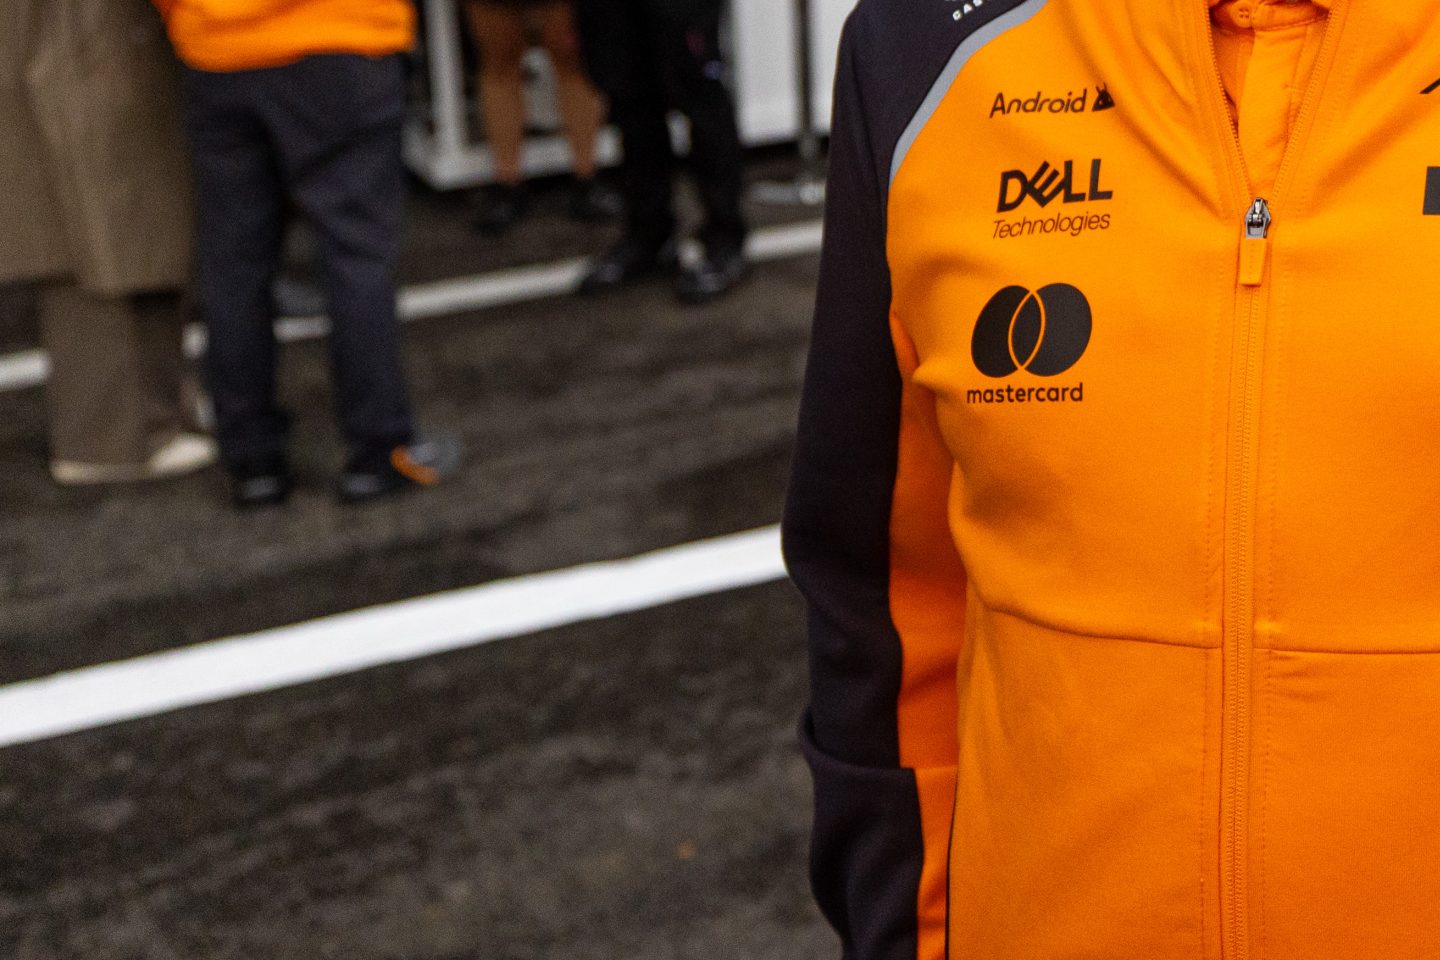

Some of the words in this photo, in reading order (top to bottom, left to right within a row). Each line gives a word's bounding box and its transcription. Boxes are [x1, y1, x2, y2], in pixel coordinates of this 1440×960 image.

[989, 88, 1088, 119] Android
[995, 158, 1114, 214] DELL
[992, 210, 1112, 240] Technologies
[966, 382, 1084, 405] mastercard
